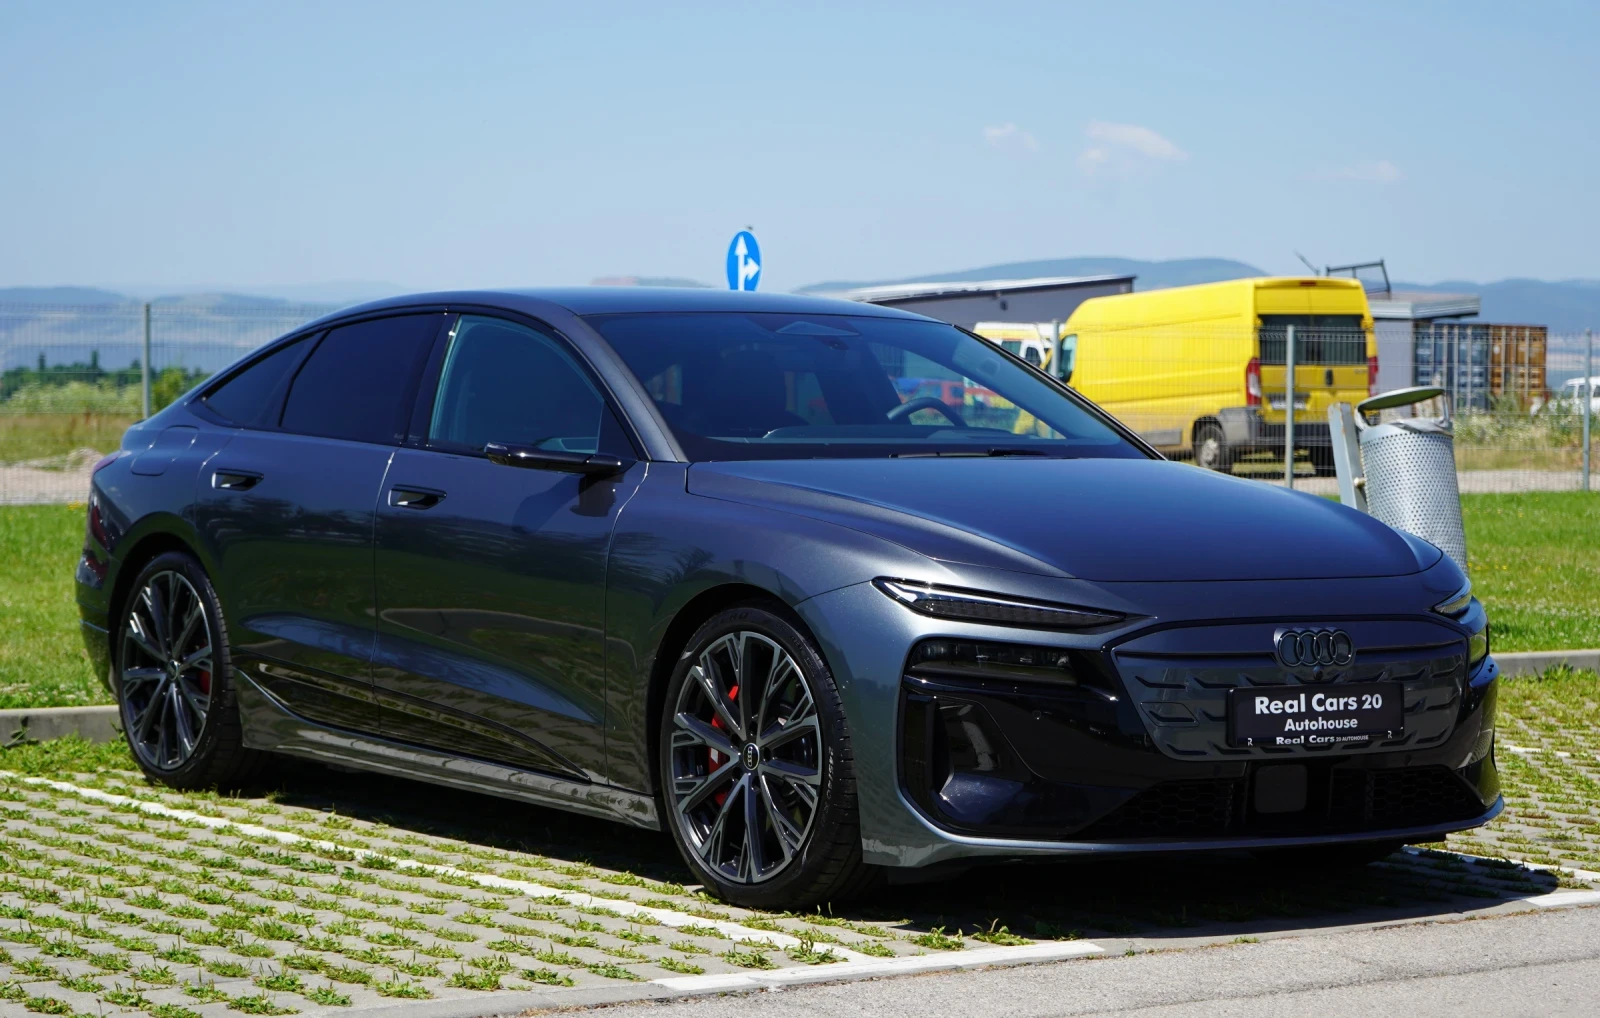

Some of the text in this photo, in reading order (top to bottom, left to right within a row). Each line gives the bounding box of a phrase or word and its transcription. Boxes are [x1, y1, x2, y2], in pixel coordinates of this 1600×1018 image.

[1255, 693, 1383, 715] Real Cars 20
[1284, 717, 1358, 732] Autohouse
[1276, 735, 1305, 745] Real
[1309, 735, 1335, 744] Cars
